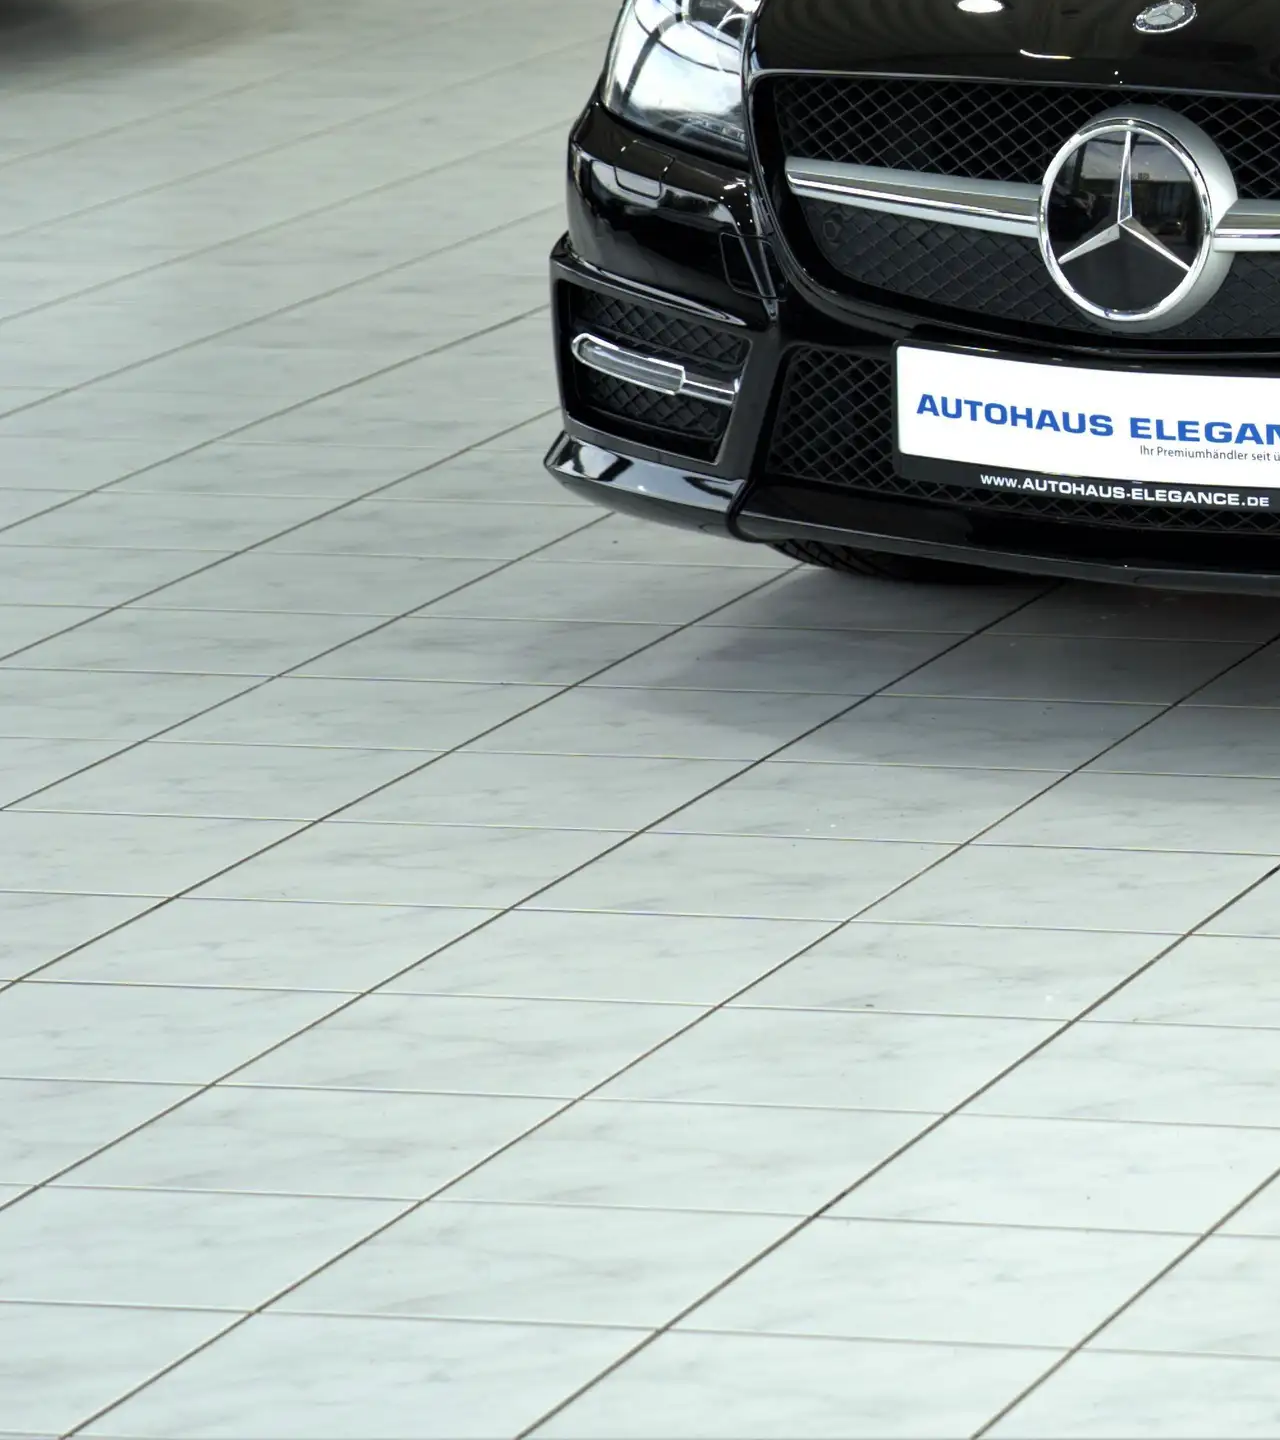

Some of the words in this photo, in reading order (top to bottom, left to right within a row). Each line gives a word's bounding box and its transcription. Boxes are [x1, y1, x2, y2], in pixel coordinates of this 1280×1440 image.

[916, 393, 1114, 437] AUTOHAUS
[1140, 445, 1154, 456] Ihr
[1156, 446, 1248, 460] Premiumhändler
[1251, 452, 1271, 462] seit
